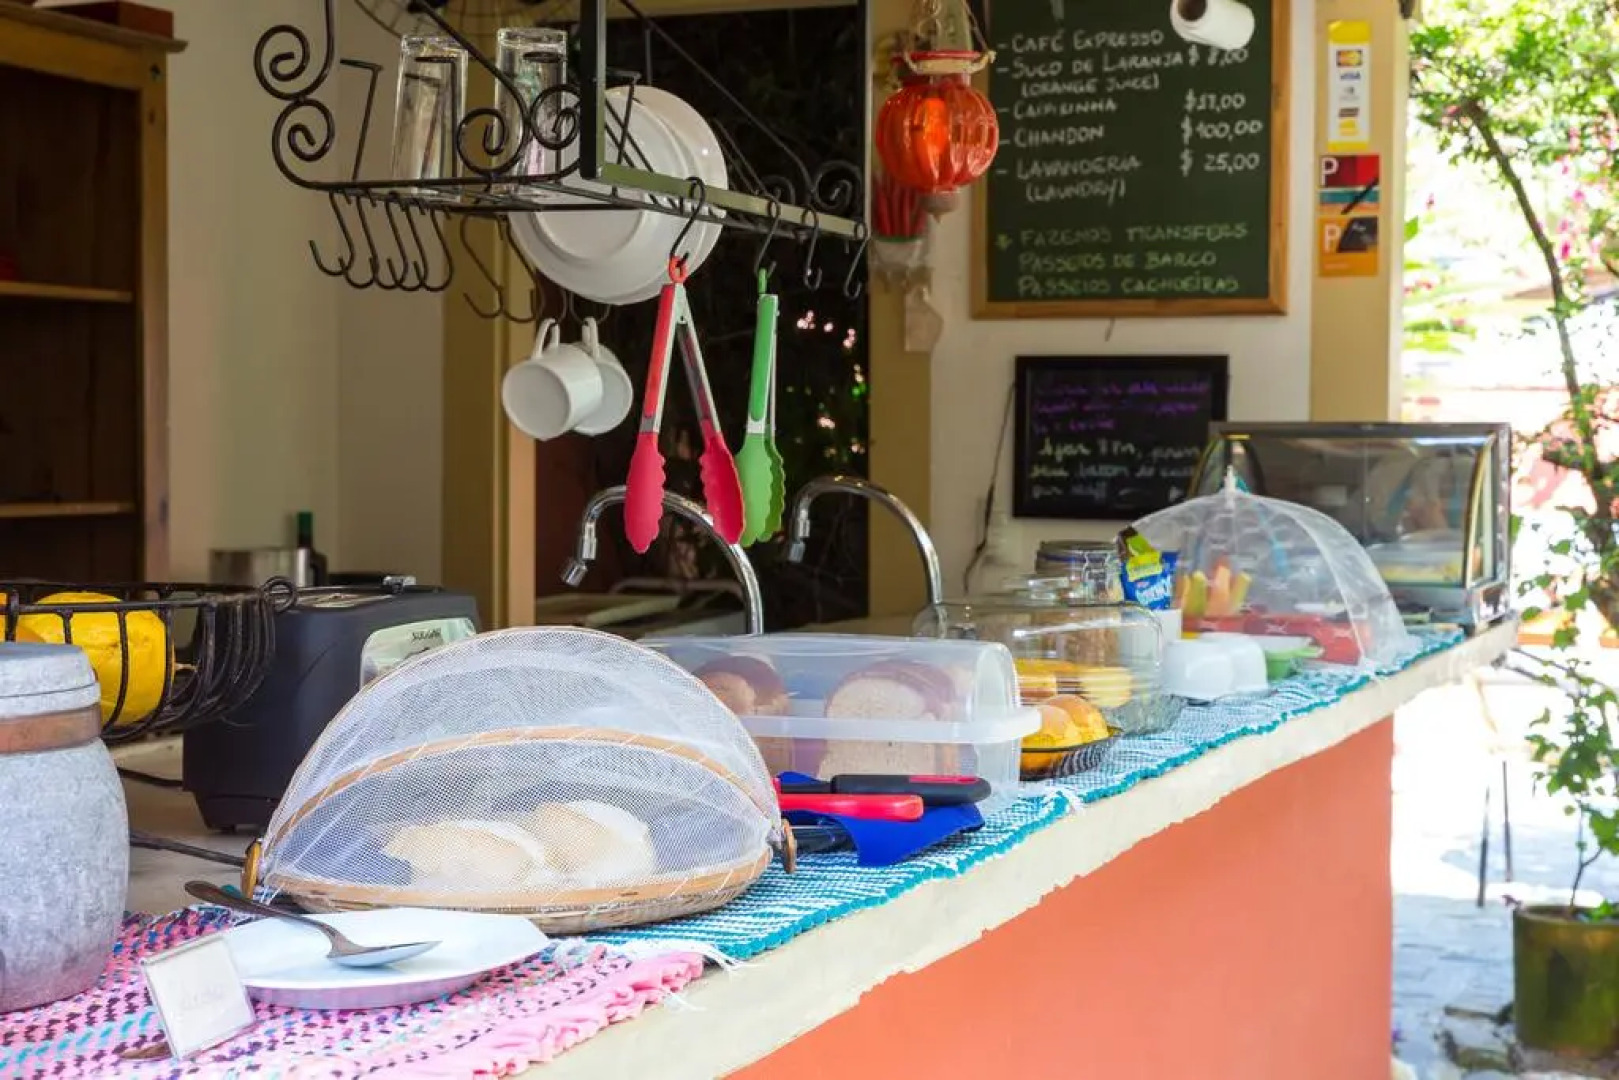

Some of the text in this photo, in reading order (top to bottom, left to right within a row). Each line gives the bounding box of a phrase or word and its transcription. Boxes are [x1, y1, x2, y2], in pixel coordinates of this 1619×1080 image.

[1011, 57, 1063, 78] SUCO
[1072, 56, 1093, 73] DE
[1102, 52, 1183, 72] LARANJA
[1014, 125, 1105, 148] CHANDON
[1016, 155, 1142, 180] LAVANDERIA
[1203, 152, 1261, 175] 25,00
[1020, 228, 1112, 248] FAZEMOS
[1112, 253, 1136, 269] DE
[1144, 250, 1217, 270] BARCO
